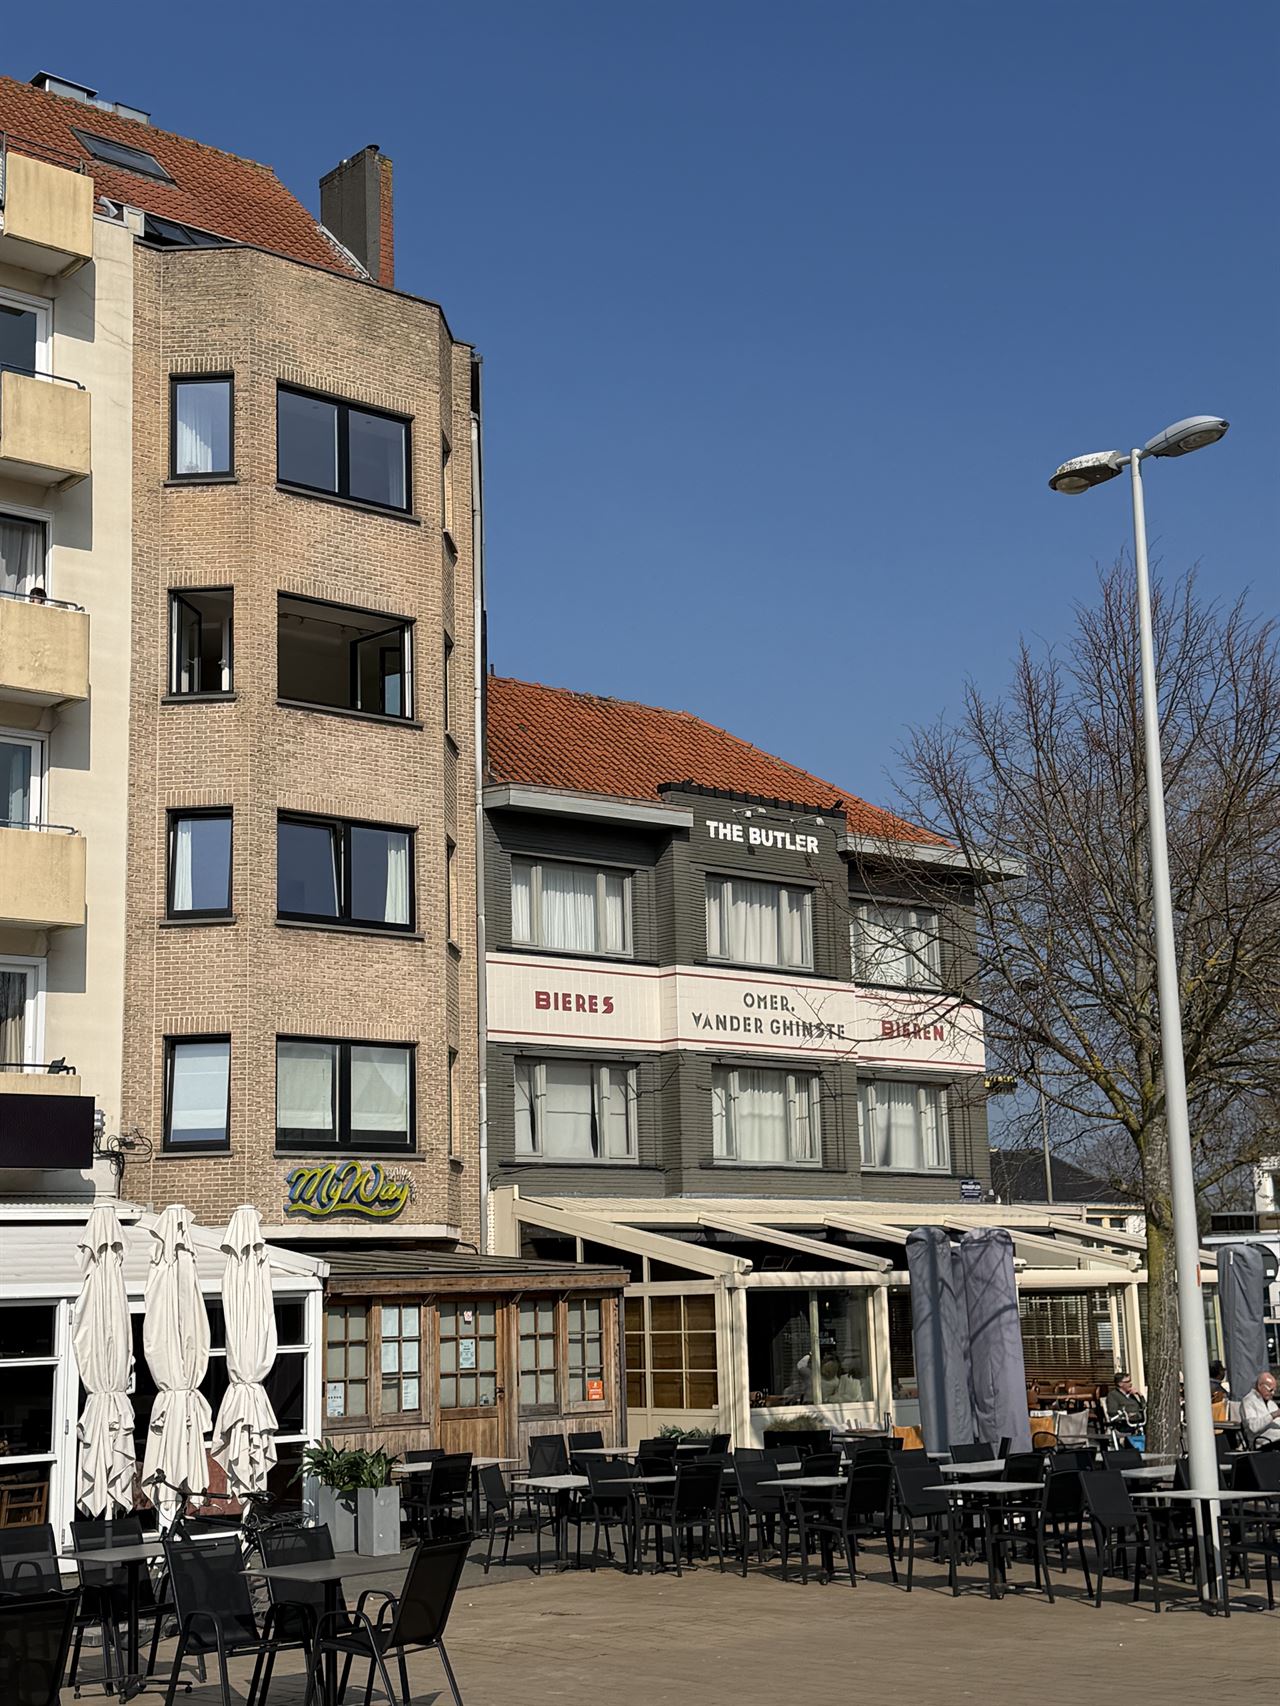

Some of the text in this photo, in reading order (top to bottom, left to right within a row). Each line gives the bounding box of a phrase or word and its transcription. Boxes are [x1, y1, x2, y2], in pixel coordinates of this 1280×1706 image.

[706, 820, 819, 854] THE BUTLER
[535, 991, 614, 1014] BIERES
[692, 1012, 845, 1041] VANDER GHINSTE
[881, 1020, 944, 1041] BIEREN
